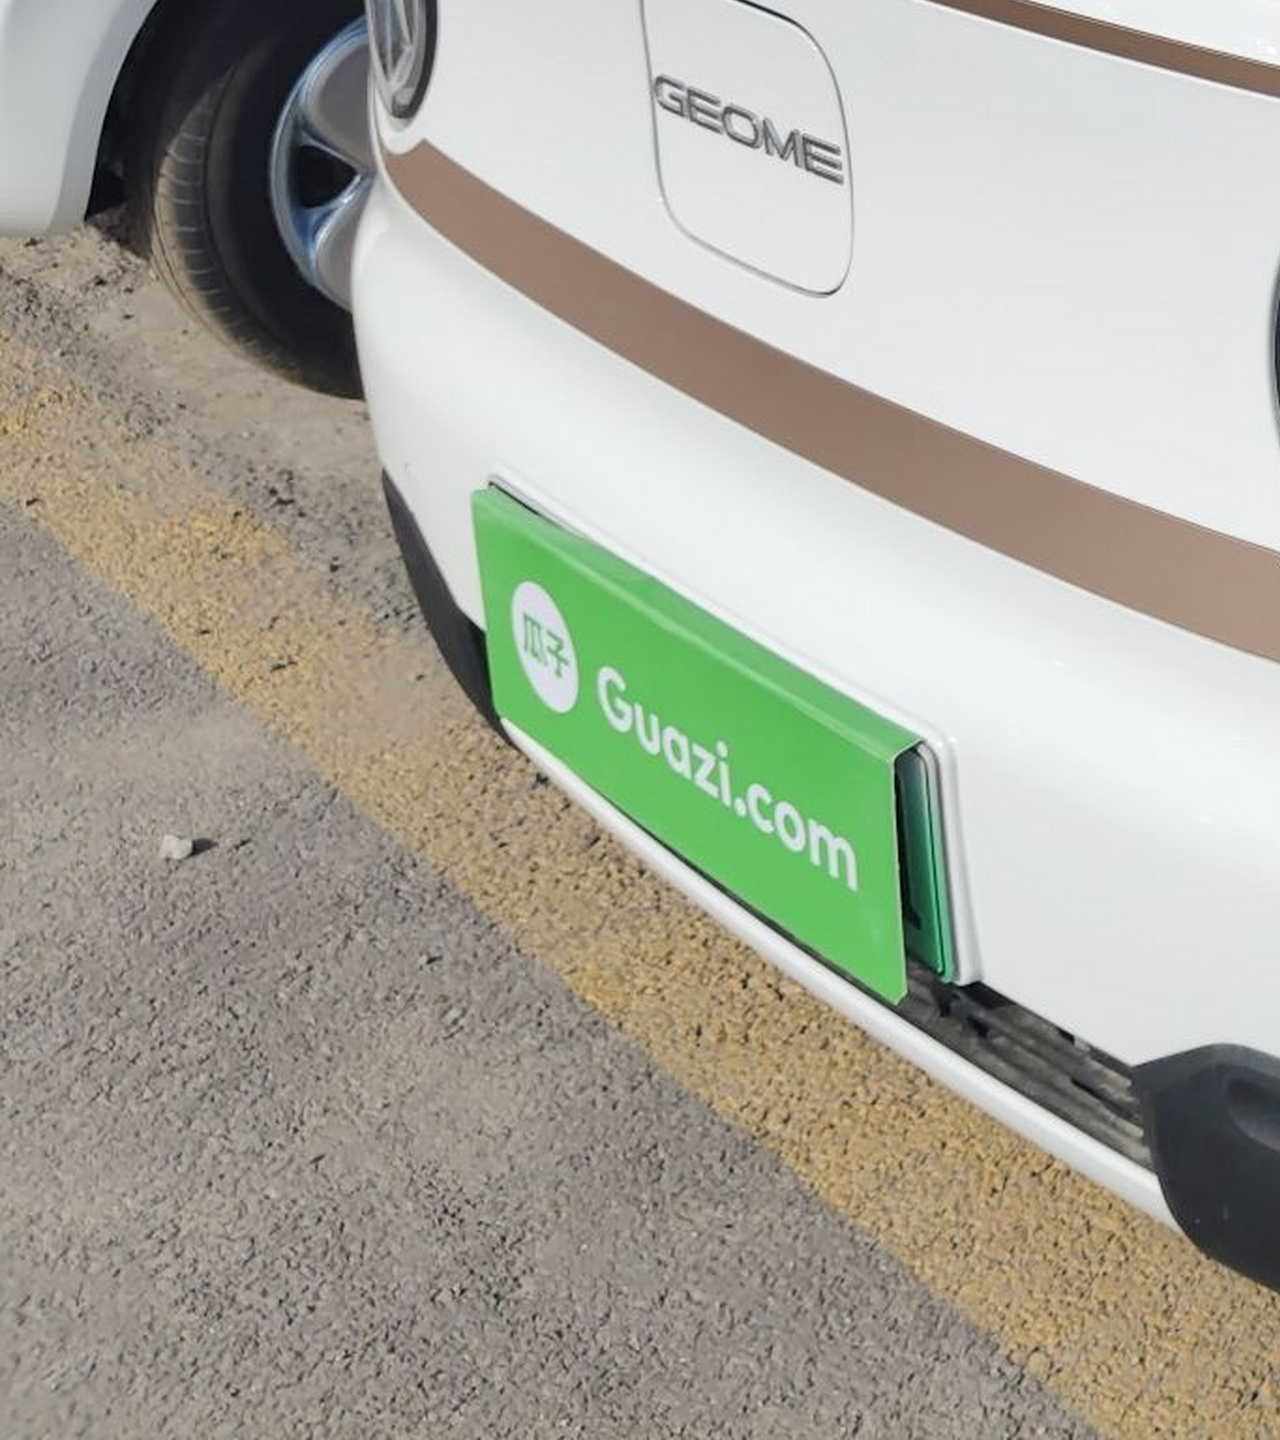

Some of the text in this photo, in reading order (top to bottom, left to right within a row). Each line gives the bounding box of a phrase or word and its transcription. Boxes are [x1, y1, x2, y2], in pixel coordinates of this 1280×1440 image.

[654, 73, 844, 186] GEOME
[523, 612, 568, 679] 瓜子
[597, 665, 858, 892] Guazi.com
